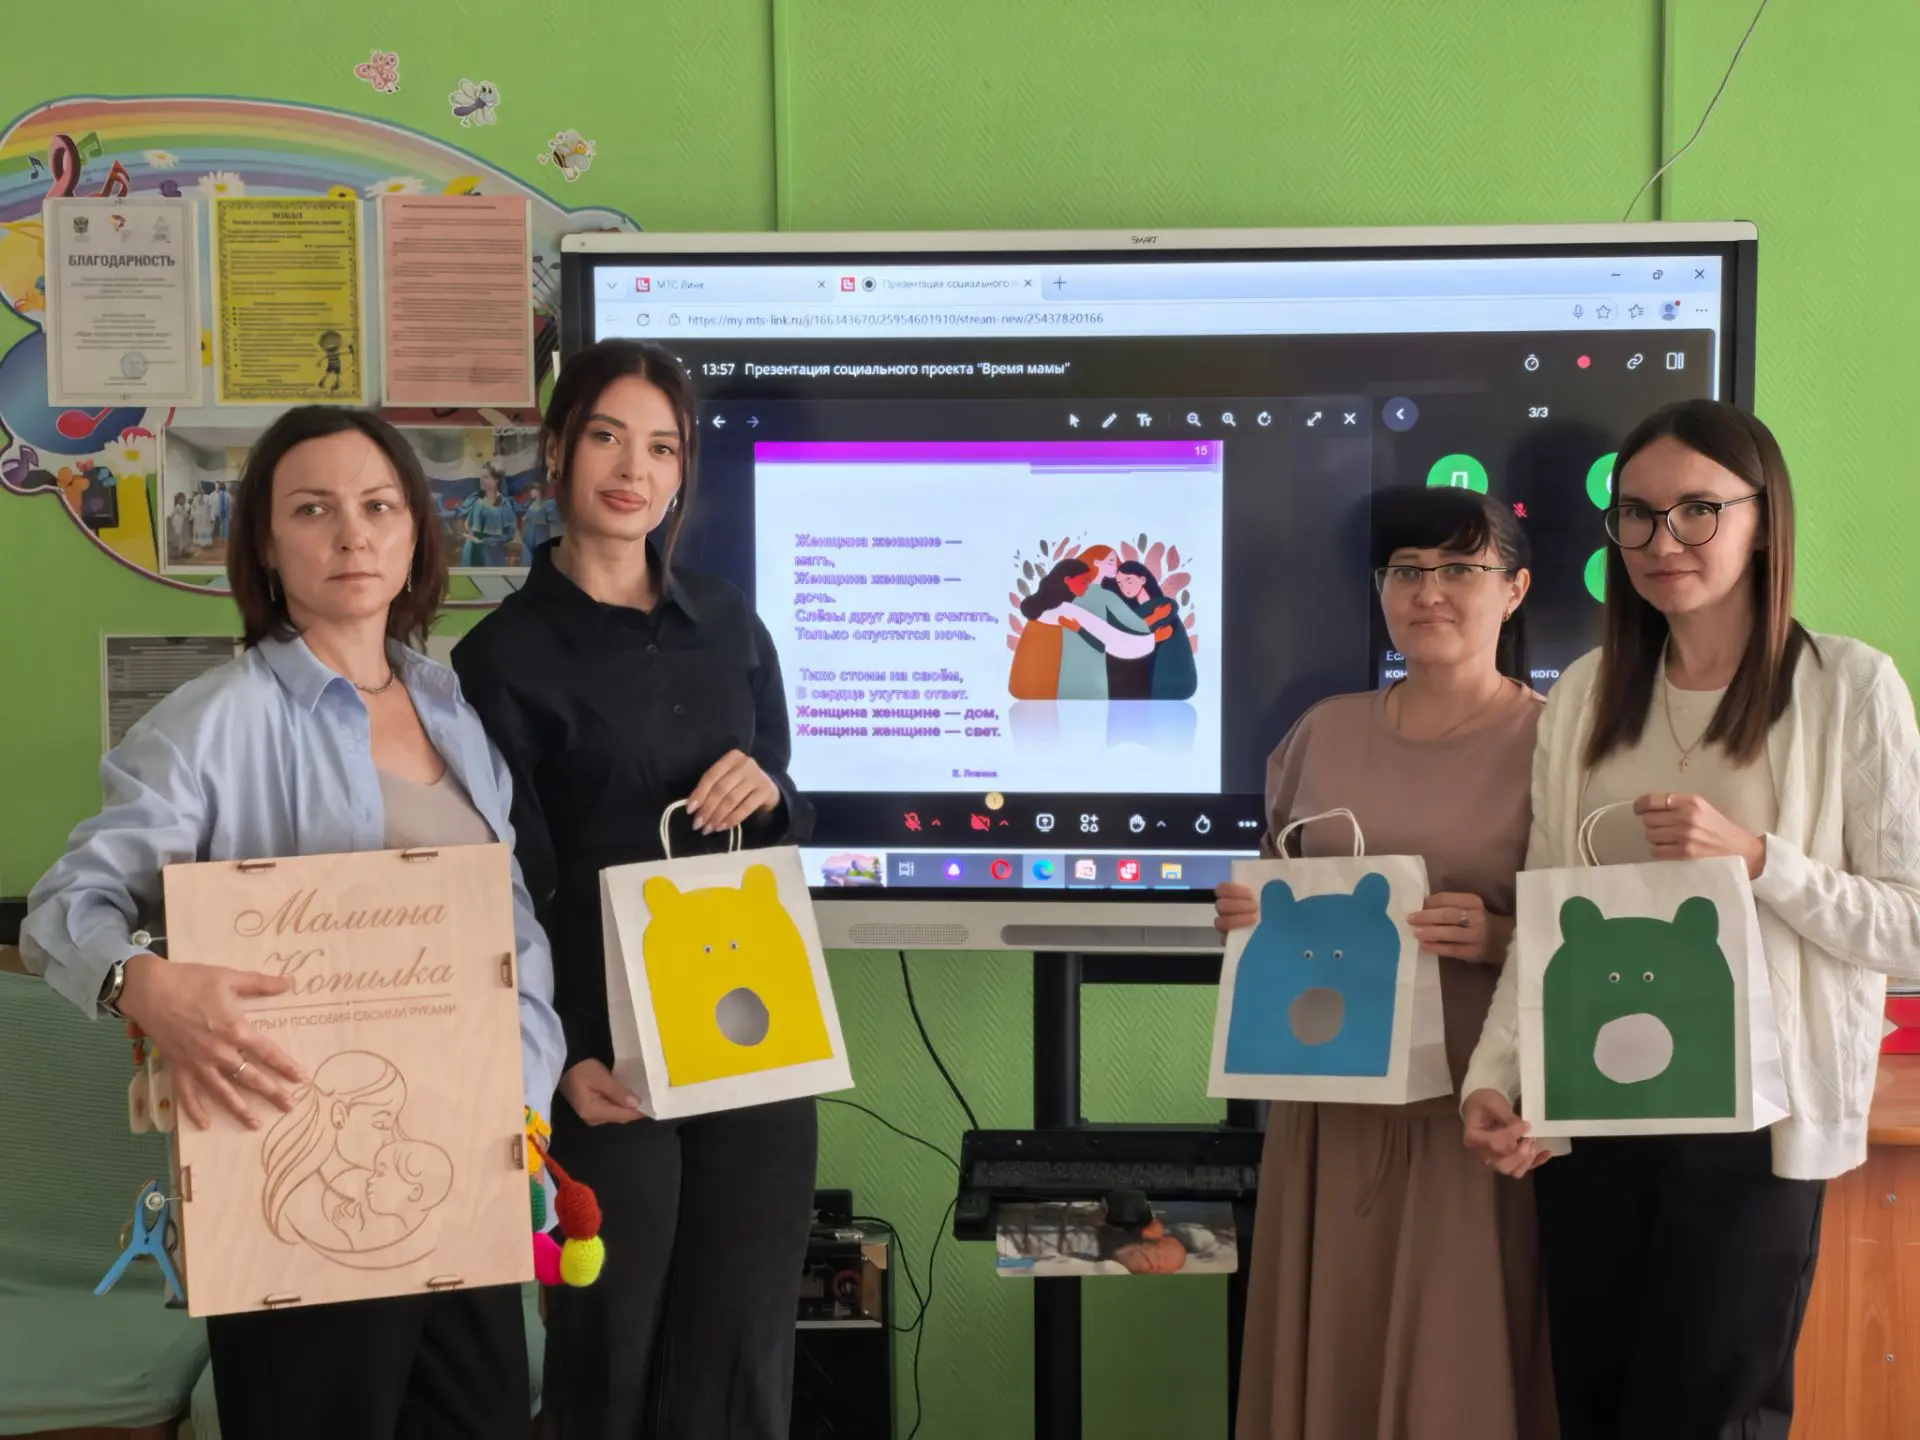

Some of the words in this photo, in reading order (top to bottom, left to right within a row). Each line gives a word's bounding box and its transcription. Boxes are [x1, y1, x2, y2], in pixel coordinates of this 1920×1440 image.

[1131, 235, 1158, 244] SMART
[68, 254, 176, 268] БЛАГОДАРНОСТЬ
[656, 280, 679, 289] МТС
[680, 280, 705, 289] Линк
[882, 278, 944, 290] Презентация
[949, 279, 1009, 289] социального
[702, 363, 736, 376] 13:57
[745, 363, 831, 378] Презентация
[833, 364, 918, 376] социального
[921, 364, 974, 377] проекта
[977, 362, 1024, 378] "Время
[1027, 361, 1071, 375] мамы"
[1528, 407, 1549, 418] 3/3
[1194, 445, 1208, 456] 15
[795, 534, 868, 549] Женщина
[872, 536, 942, 549] женщине
[794, 555, 836, 568] мать,
[794, 571, 867, 586] Женщина
[870, 573, 941, 586] женщине
[848, 611, 885, 625] друг
[887, 611, 931, 625] друга
[934, 611, 999, 624] считать,
[795, 627, 849, 641] Только
[852, 629, 931, 643] опустится
[799, 668, 836, 681] Тихо
[839, 670, 886, 682] стоим
[890, 670, 908, 682] на
[1531, 669, 1560, 678] кого
[796, 686, 807, 699] В
[811, 688, 865, 701] сердце
[924, 688, 969, 700] ответ.
[796, 705, 868, 720] Женщина
[872, 708, 941, 720] женщине
[964, 708, 999, 720] дом,
[796, 724, 868, 738] Женщина
[872, 726, 941, 738] женщине
[964, 726, 1001, 738] свет.
[234, 887, 448, 938] Мамина
[263, 946, 456, 996] Копилка
[279, 1018, 288, 1029] И
[290, 1013, 351, 1027] ПОСОБИЯ
[353, 1010, 408, 1022] СВОИМИ
[410, 1004, 457, 1018] РУКАМИ
